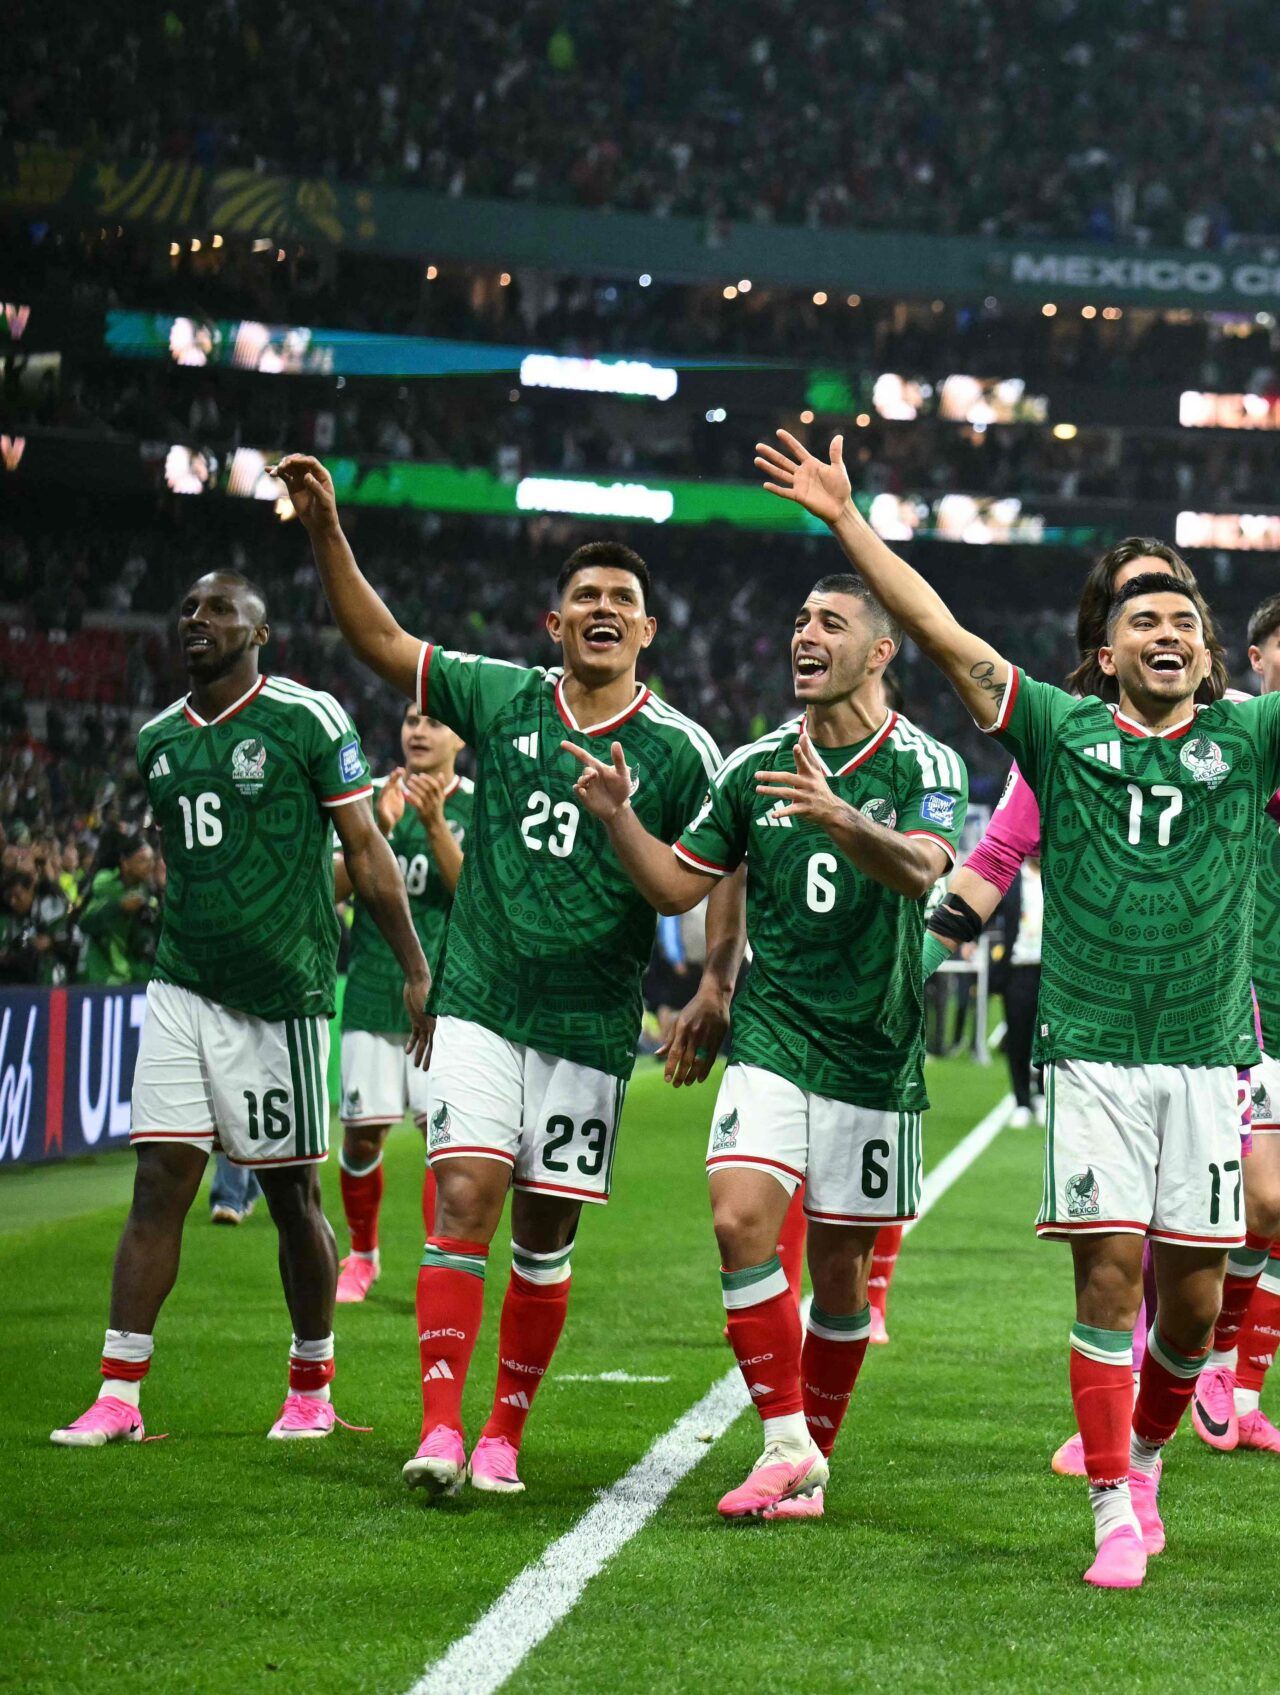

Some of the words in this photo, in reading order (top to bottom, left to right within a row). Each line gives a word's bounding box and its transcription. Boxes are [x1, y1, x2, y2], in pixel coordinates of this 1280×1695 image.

[1011, 253, 1223, 294] MEXICO
[178, 791, 224, 850] 16
[520, 790, 580, 858] 23
[1126, 784, 1183, 847] 17
[806, 852, 838, 913] 6
[243, 1088, 291, 1141] 16
[542, 1114, 608, 1176] 23
[861, 1139, 890, 1199] 6
[1208, 1160, 1241, 1225] 17
